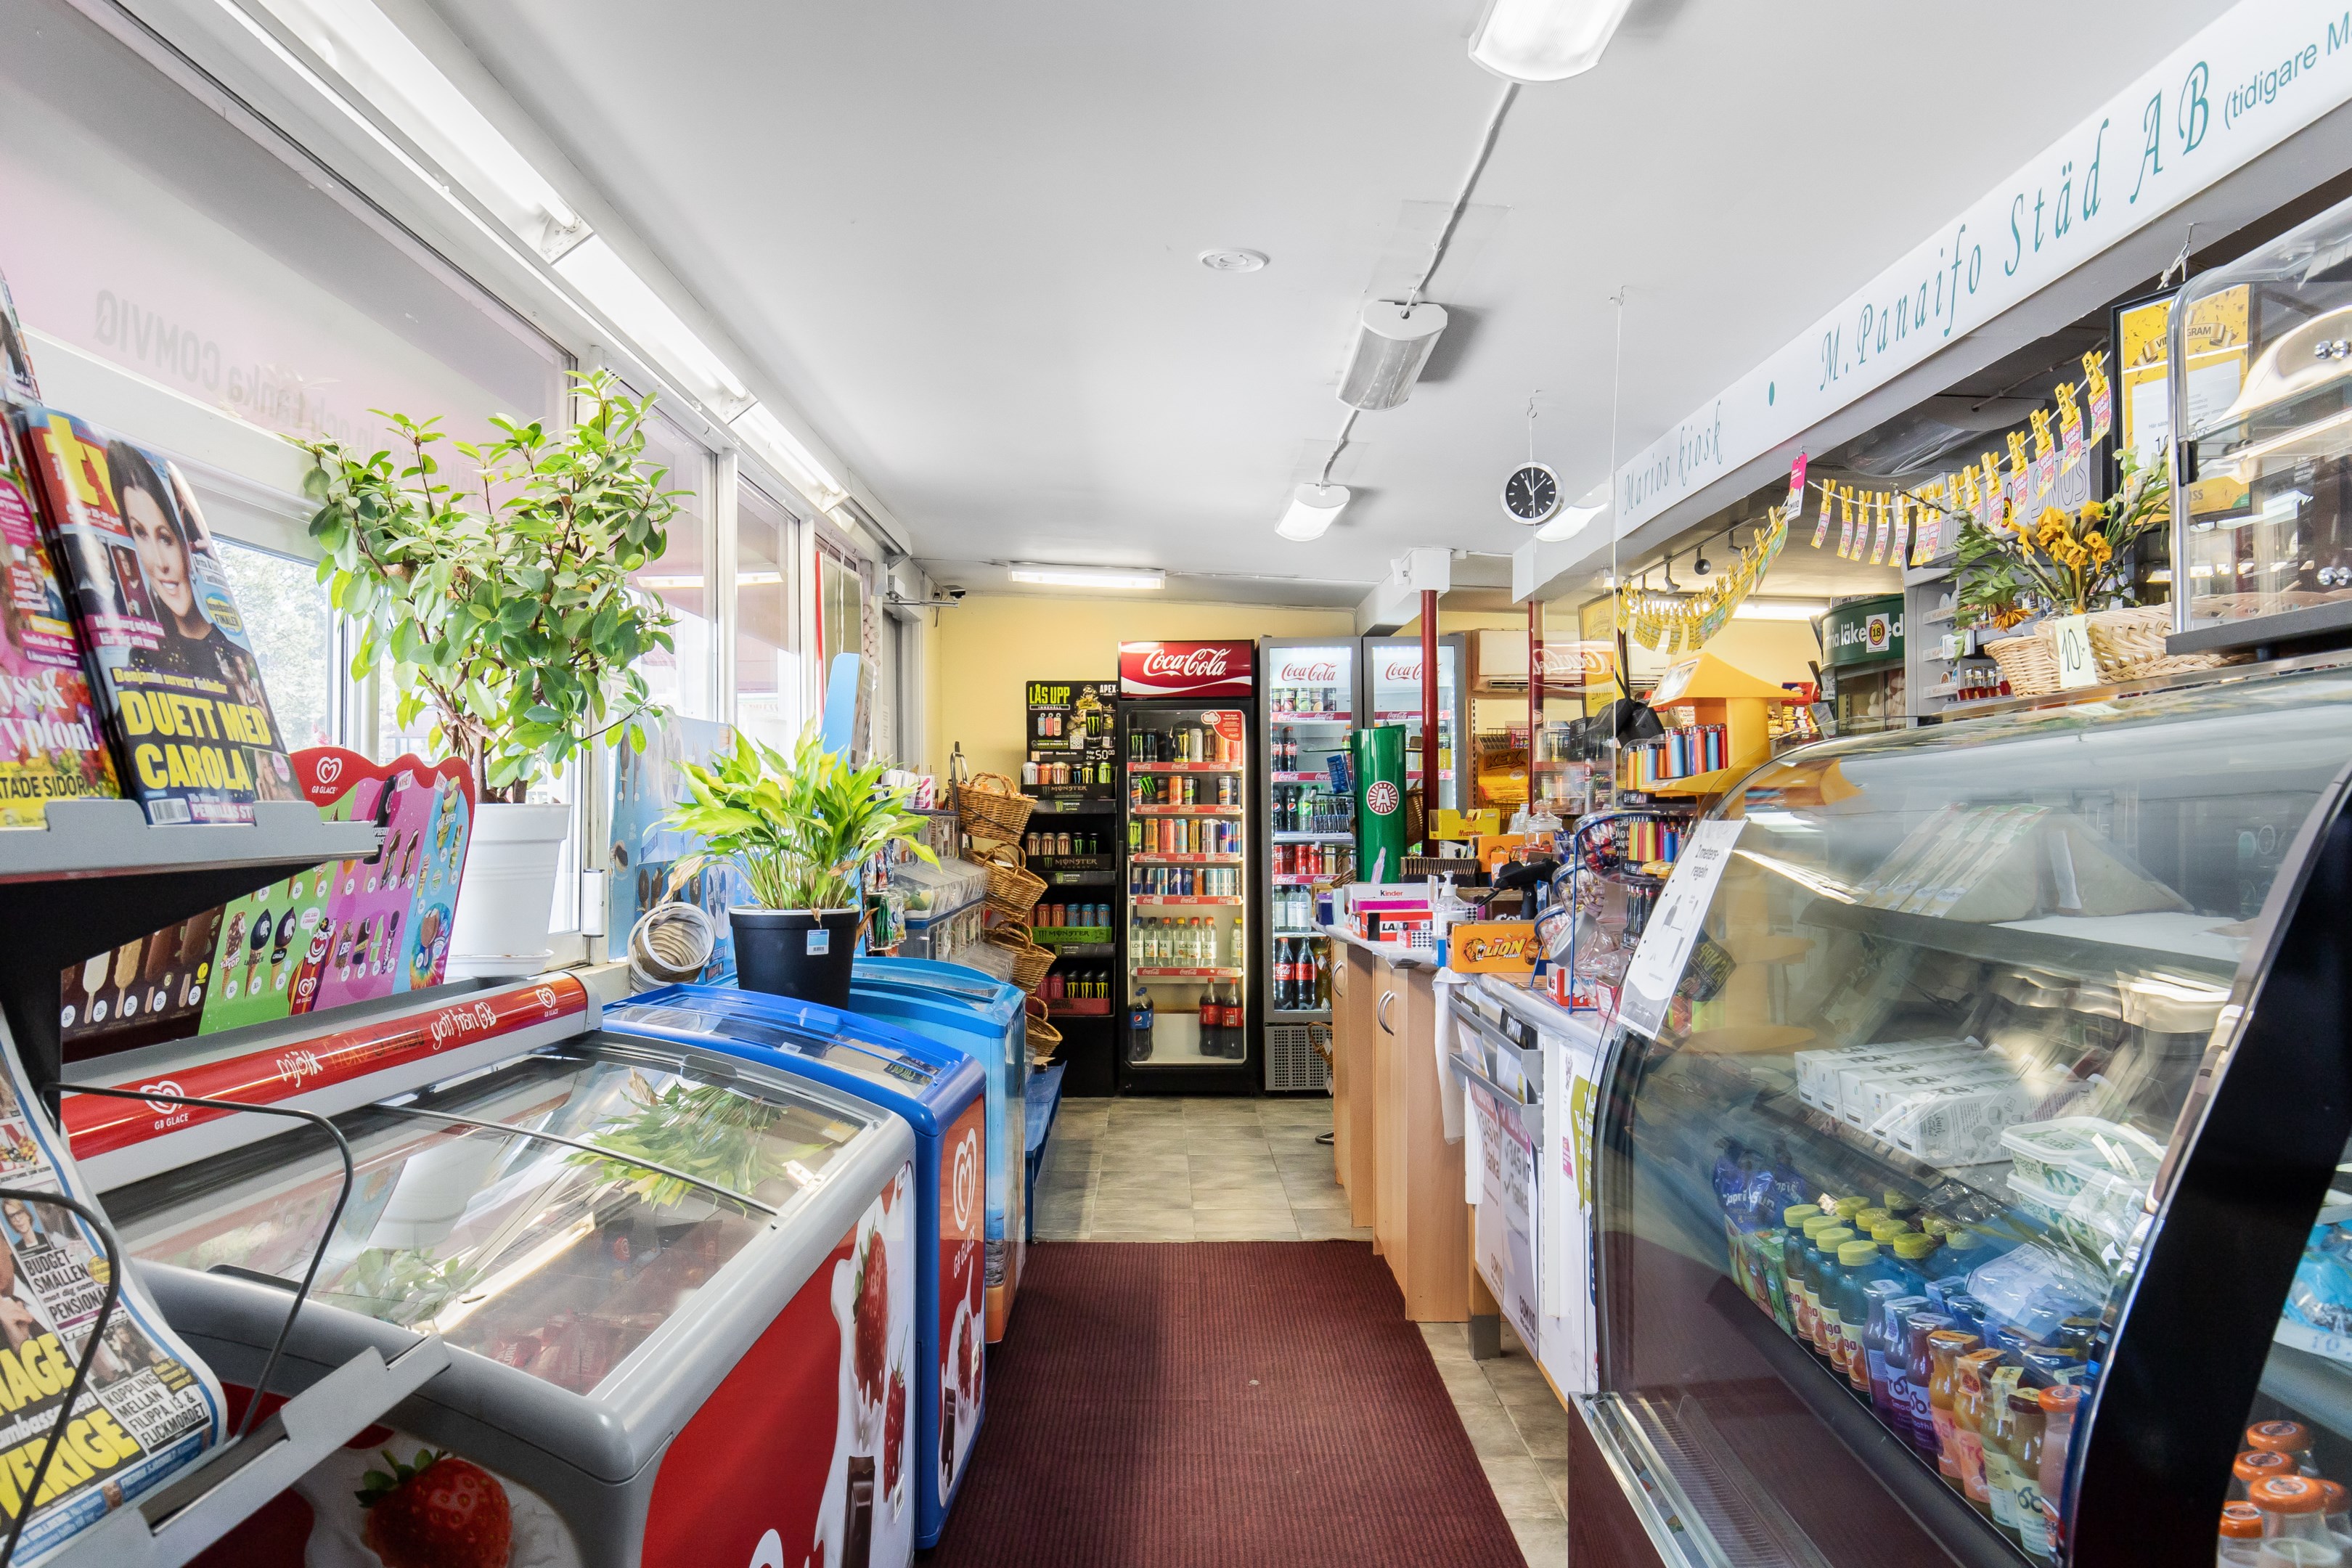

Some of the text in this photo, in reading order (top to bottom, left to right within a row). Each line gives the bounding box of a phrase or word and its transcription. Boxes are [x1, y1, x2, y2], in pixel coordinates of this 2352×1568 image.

[1623, 459, 1670, 516] Marios
[1856, 223, 1982, 364] Panaifo
[2004, 117, 2110, 277] Städ
[2129, 60, 2210, 205] AB
[2224, 44, 2317, 130] (tidigare
[2327, 11, 2352, 56] M
[1872, 626, 1882, 638] 18
[1143, 648, 1232, 677] Coca-Cola
[1281, 662, 1338, 682] Coca-Cola
[1029, 683, 1070, 704] LÅS UPP
[1100, 684, 1116, 693] APEX
[117, 690, 272, 746] DUETT MED
[134, 743, 253, 791] CAROLA
[44, 774, 87, 797] SIDOR
[319, 785, 337, 794] GLACE
[1485, 937, 1527, 957] LION
[276, 1050, 323, 1088] mjölk
[430, 1010, 454, 1050] gott
[454, 1006, 480, 1038] från
[478, 1001, 497, 1030] GB
[155, 1113, 189, 1130] GB GLACE
[24, 1249, 74, 1276] BUDGET-
[953, 1223, 976, 1279] GB GLACE
[33, 1262, 91, 1294] SMÄLLEN
[1519, 1294, 1536, 1334] COMVIQ
[104, 1373, 159, 1407] KOPPLING
[116, 1388, 165, 1419] MELLAN
[128, 1402, 173, 1433] FILIPPA,
[184, 1390, 196, 1403] &
[141, 1402, 206, 1447] FLICKMORDET
